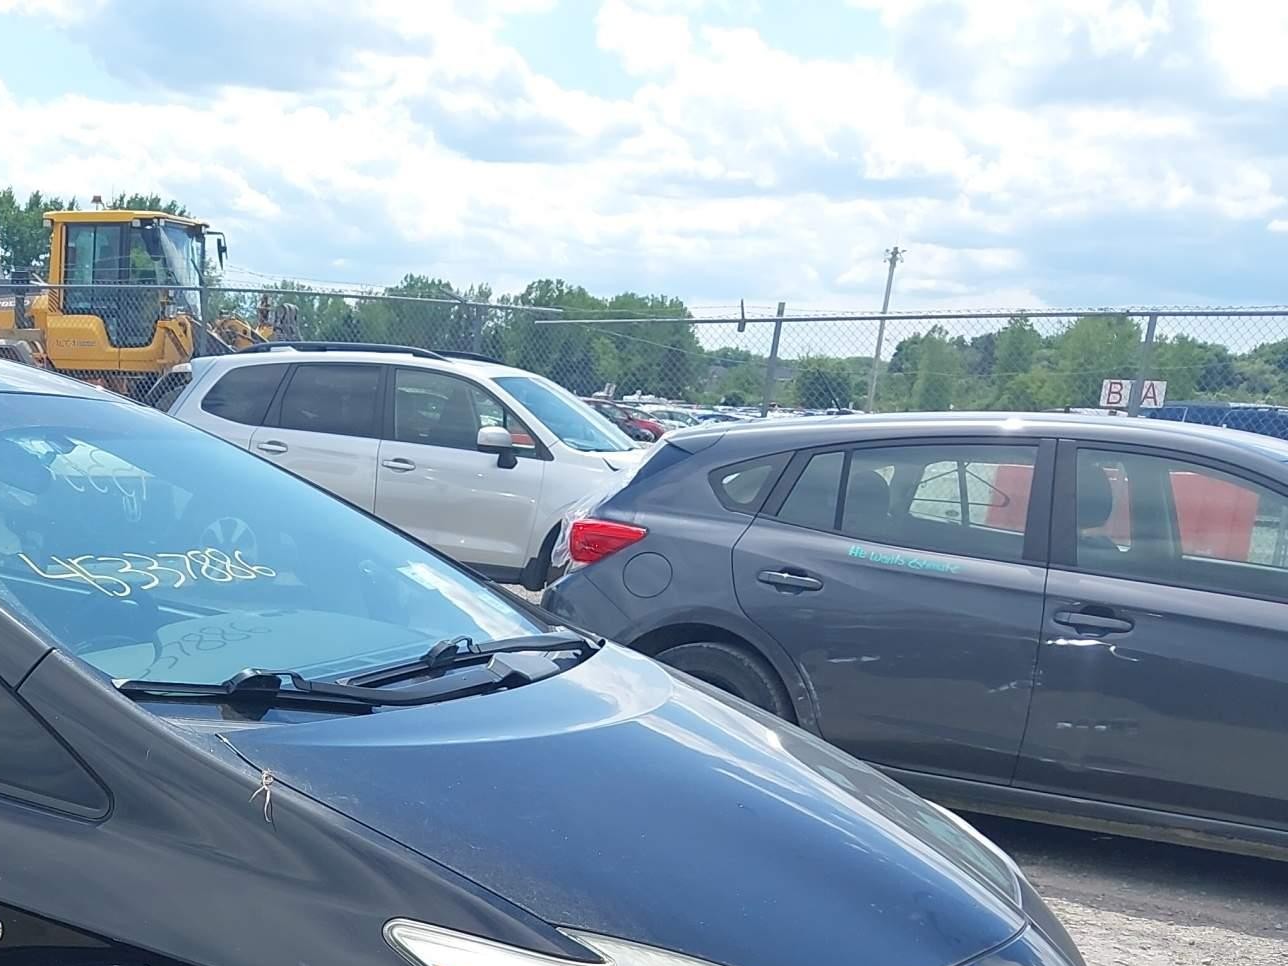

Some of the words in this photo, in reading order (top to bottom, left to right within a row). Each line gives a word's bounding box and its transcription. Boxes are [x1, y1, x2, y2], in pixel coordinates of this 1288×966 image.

[1106, 381, 1124, 405] B
[1141, 381, 1158, 406] A
[17, 547, 277, 597] 45337886
